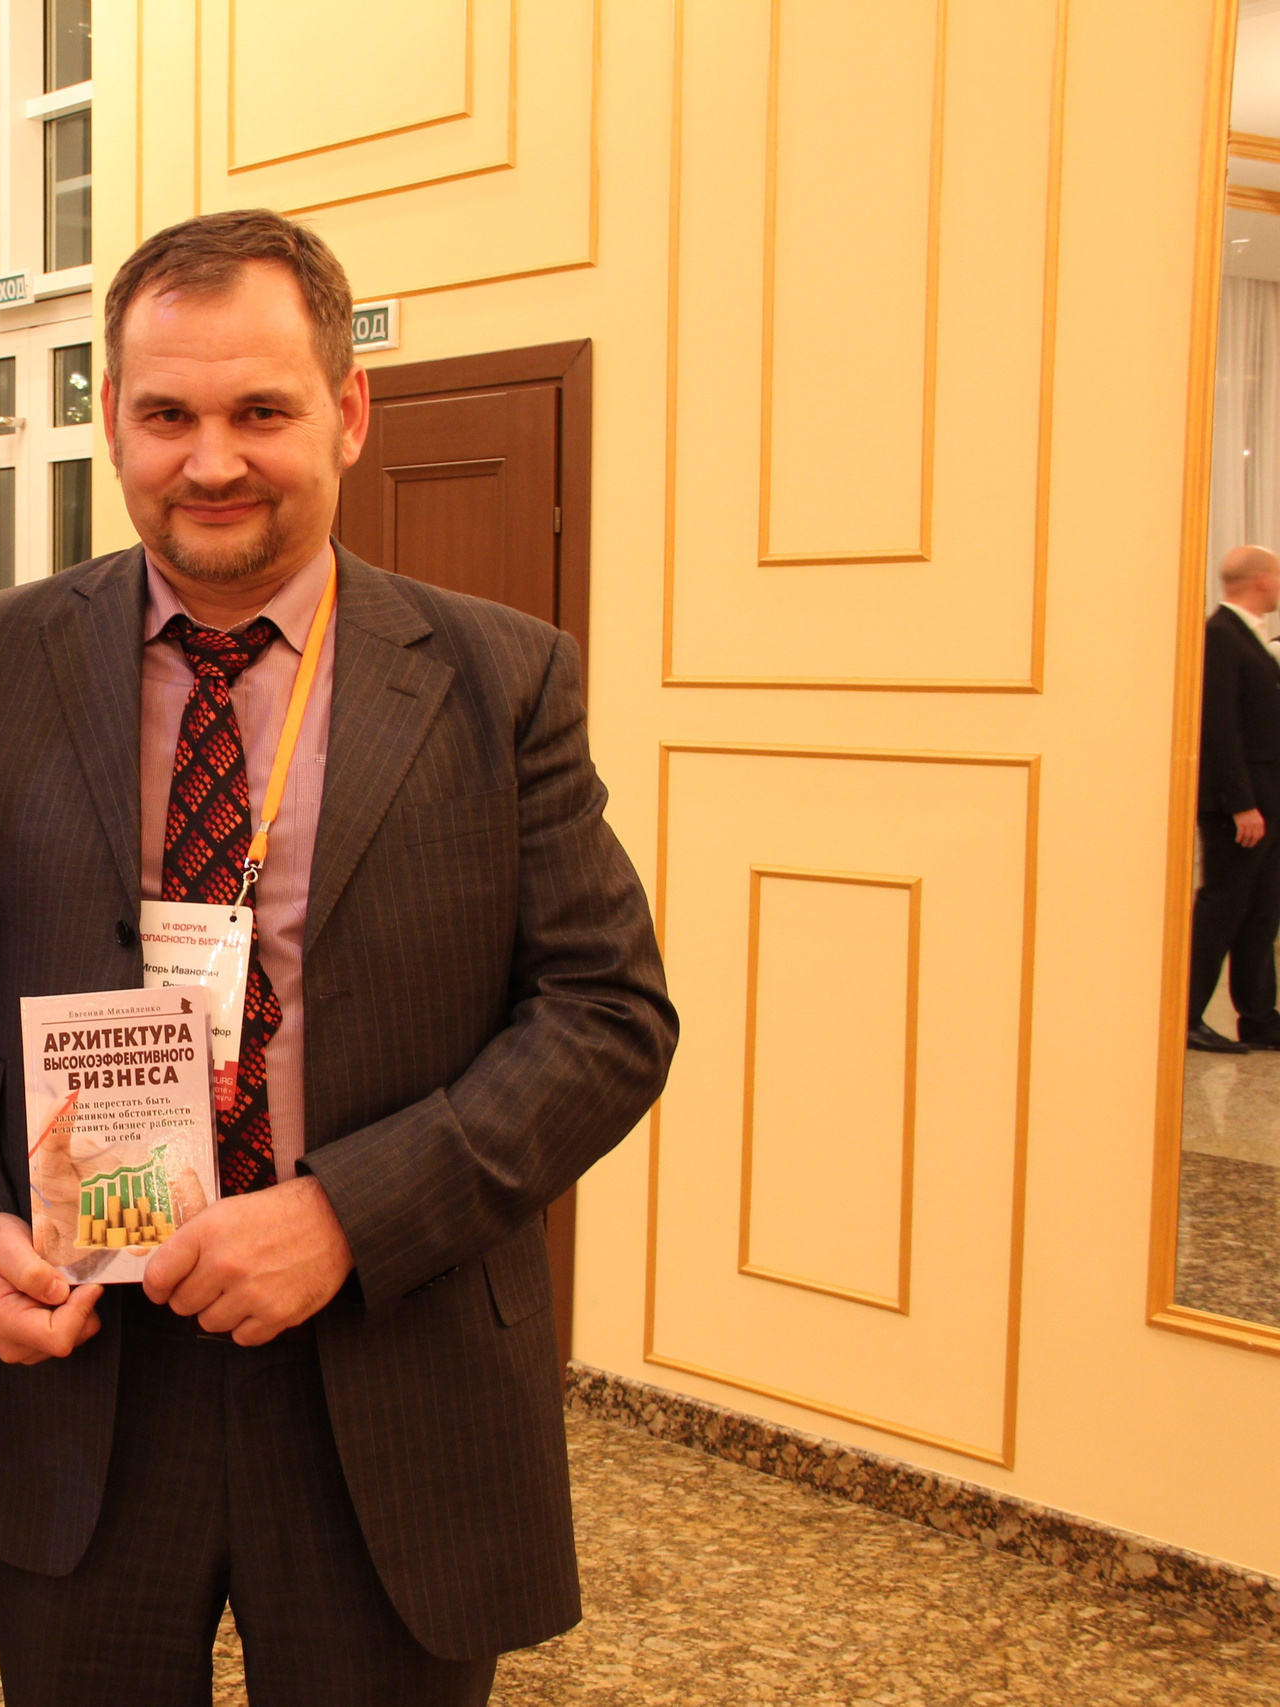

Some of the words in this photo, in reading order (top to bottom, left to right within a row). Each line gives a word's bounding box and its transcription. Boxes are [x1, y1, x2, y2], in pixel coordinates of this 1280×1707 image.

[162, 922, 170, 930] VI
[172, 923, 207, 932] ФОРУМ
[171, 965, 219, 977] Иванович
[68, 1009, 104, 1018] Евгений
[107, 1005, 161, 1016] Михайленко
[43, 1023, 193, 1053] АРХИТЕКТУРА
[43, 1047, 195, 1071] ВЫСОКОЭФФЕКТИВНОГО
[68, 1065, 179, 1091] БИЗНЕСА
[72, 1101, 90, 1110] Как
[93, 1099, 143, 1111] перестать
[145, 1096, 171, 1105] быть
[54, 1113, 116, 1123] заложником
[118, 1107, 191, 1119] обстоятельств
[60, 1124, 110, 1134] заставить
[112, 1120, 147, 1131] бизнес
[149, 1118, 195, 1130] работать
[105, 1135, 117, 1143] на
[120, 1131, 142, 1142] себя
